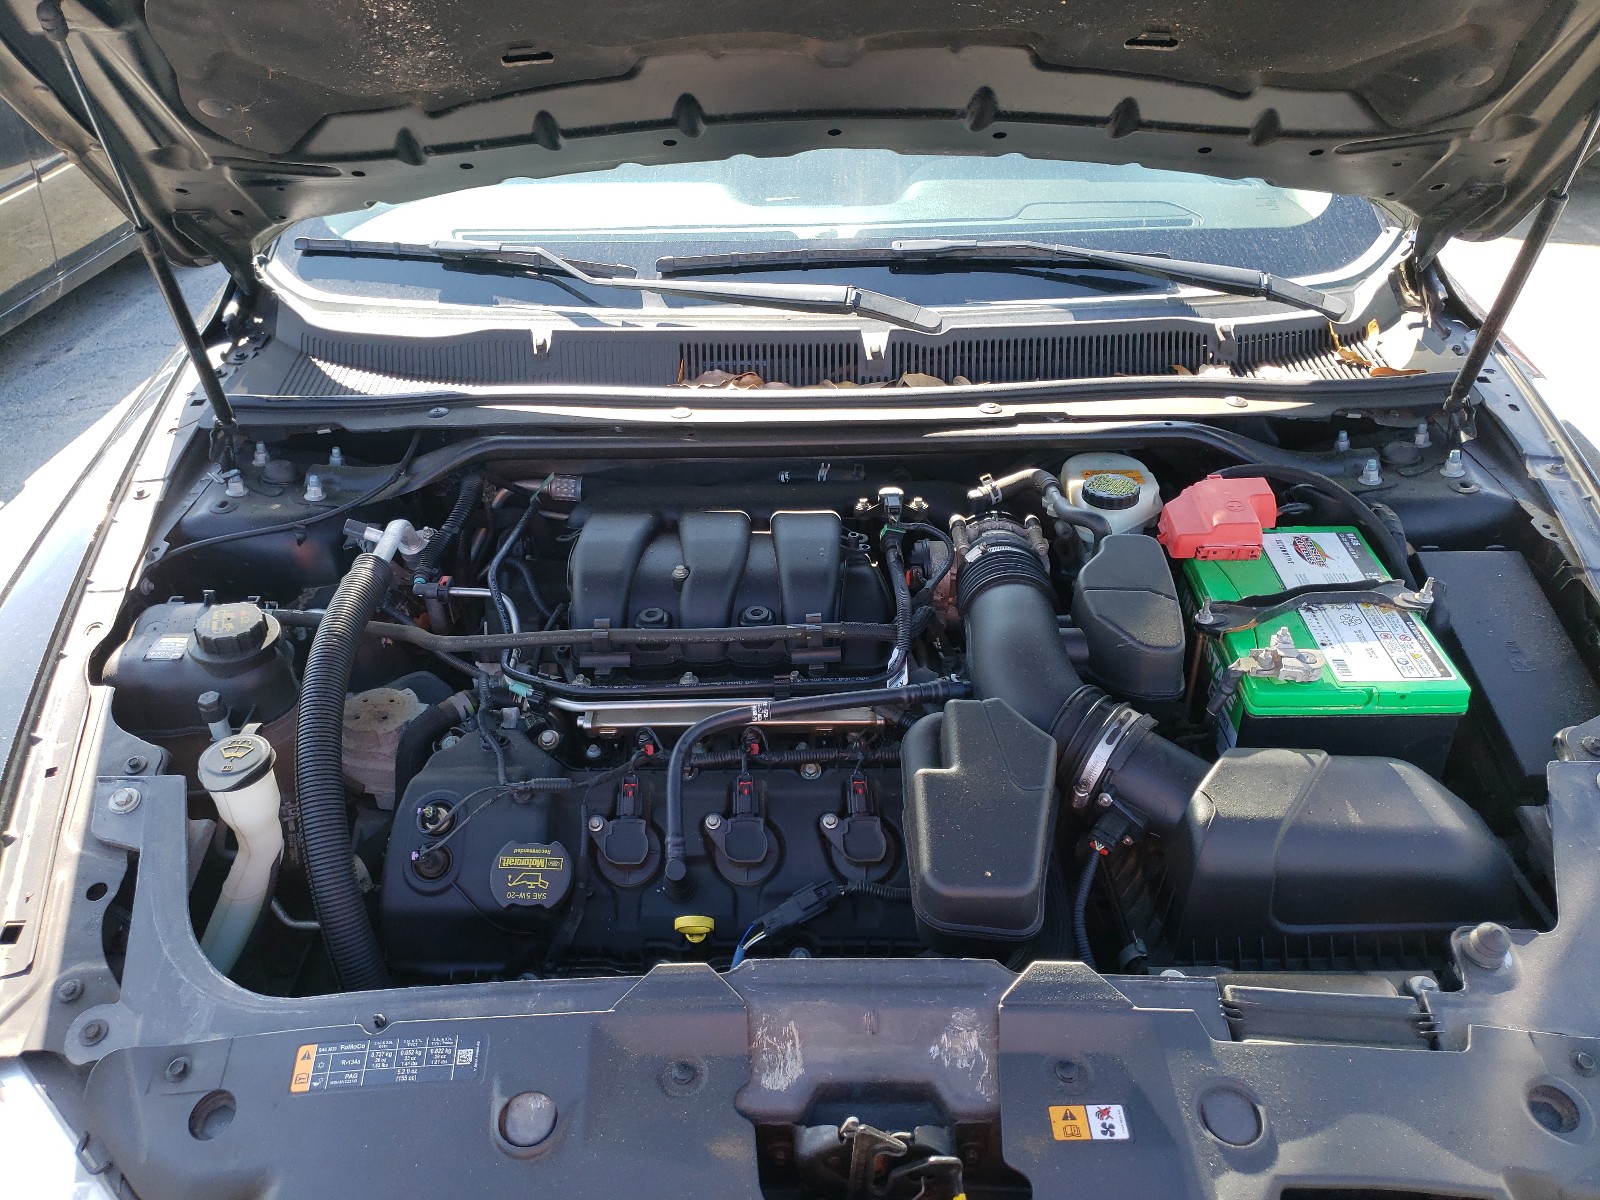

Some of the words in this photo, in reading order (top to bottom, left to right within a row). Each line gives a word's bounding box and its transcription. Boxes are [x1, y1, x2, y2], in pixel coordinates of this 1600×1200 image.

[502, 858, 545, 867] Motorcraft
[533, 892, 547, 900] SAE
[340, 1043, 366, 1051] FoMoCo
